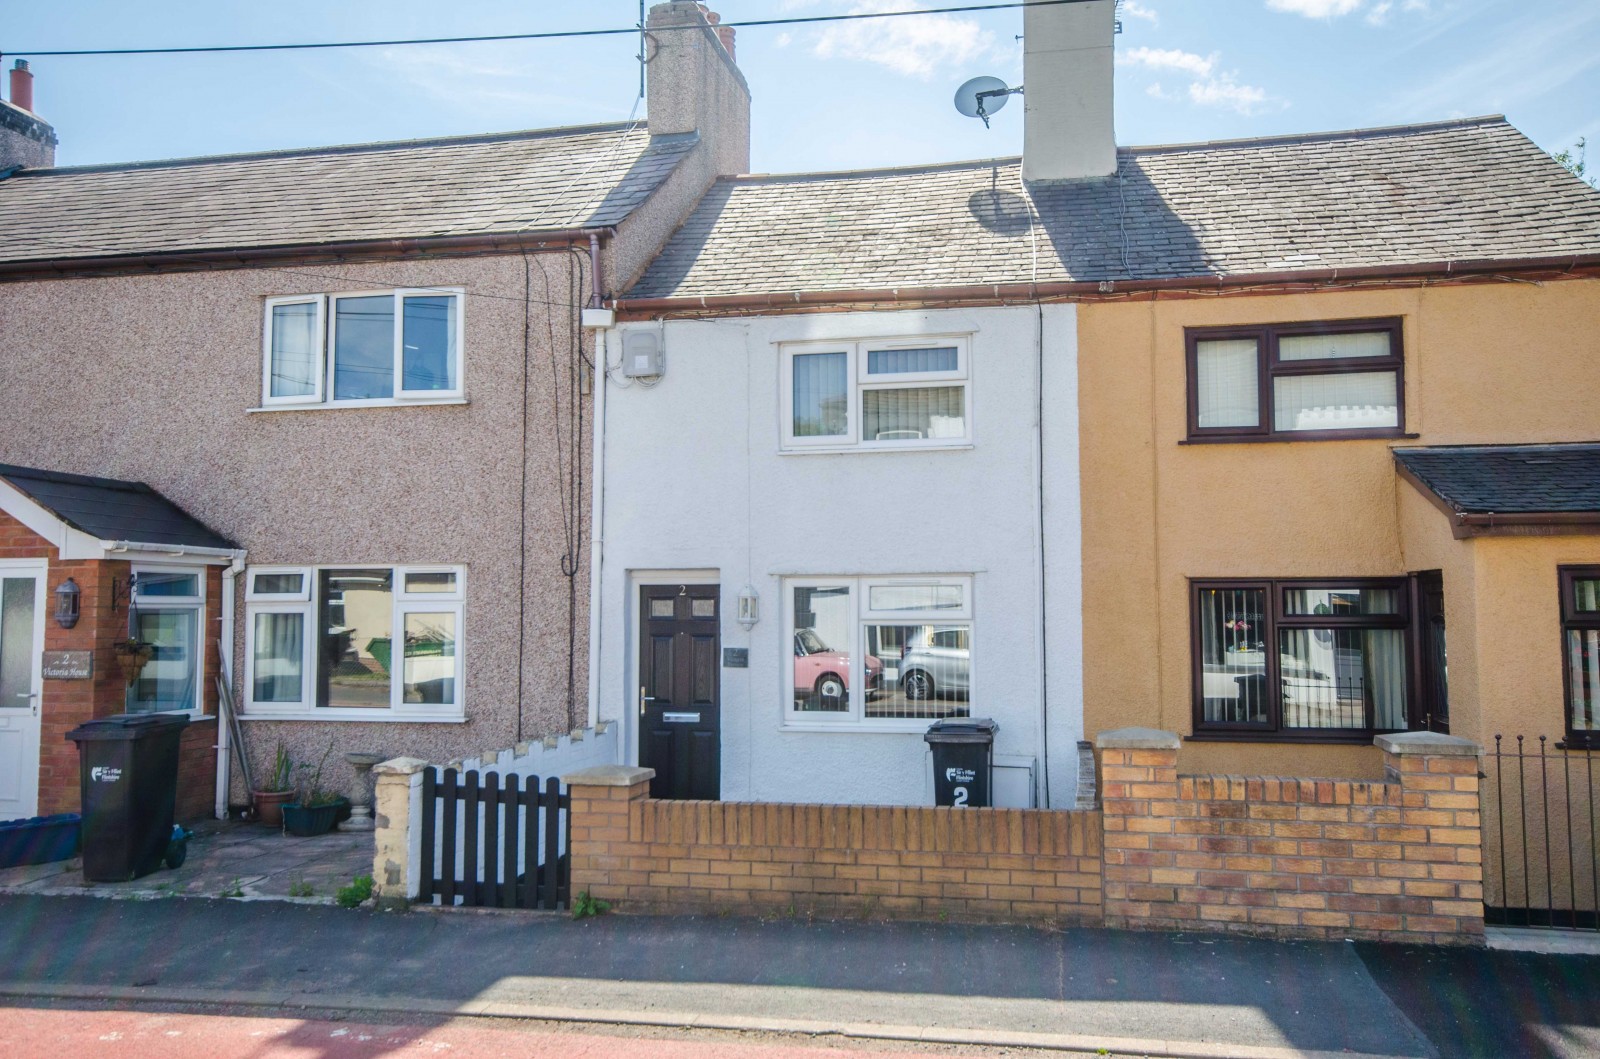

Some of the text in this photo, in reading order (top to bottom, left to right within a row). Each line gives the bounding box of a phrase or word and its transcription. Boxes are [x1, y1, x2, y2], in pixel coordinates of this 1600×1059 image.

[679, 585, 686, 595] 2
[63, 654, 69, 664] 2
[70, 668, 88, 676] House
[954, 787, 968, 807] 2
